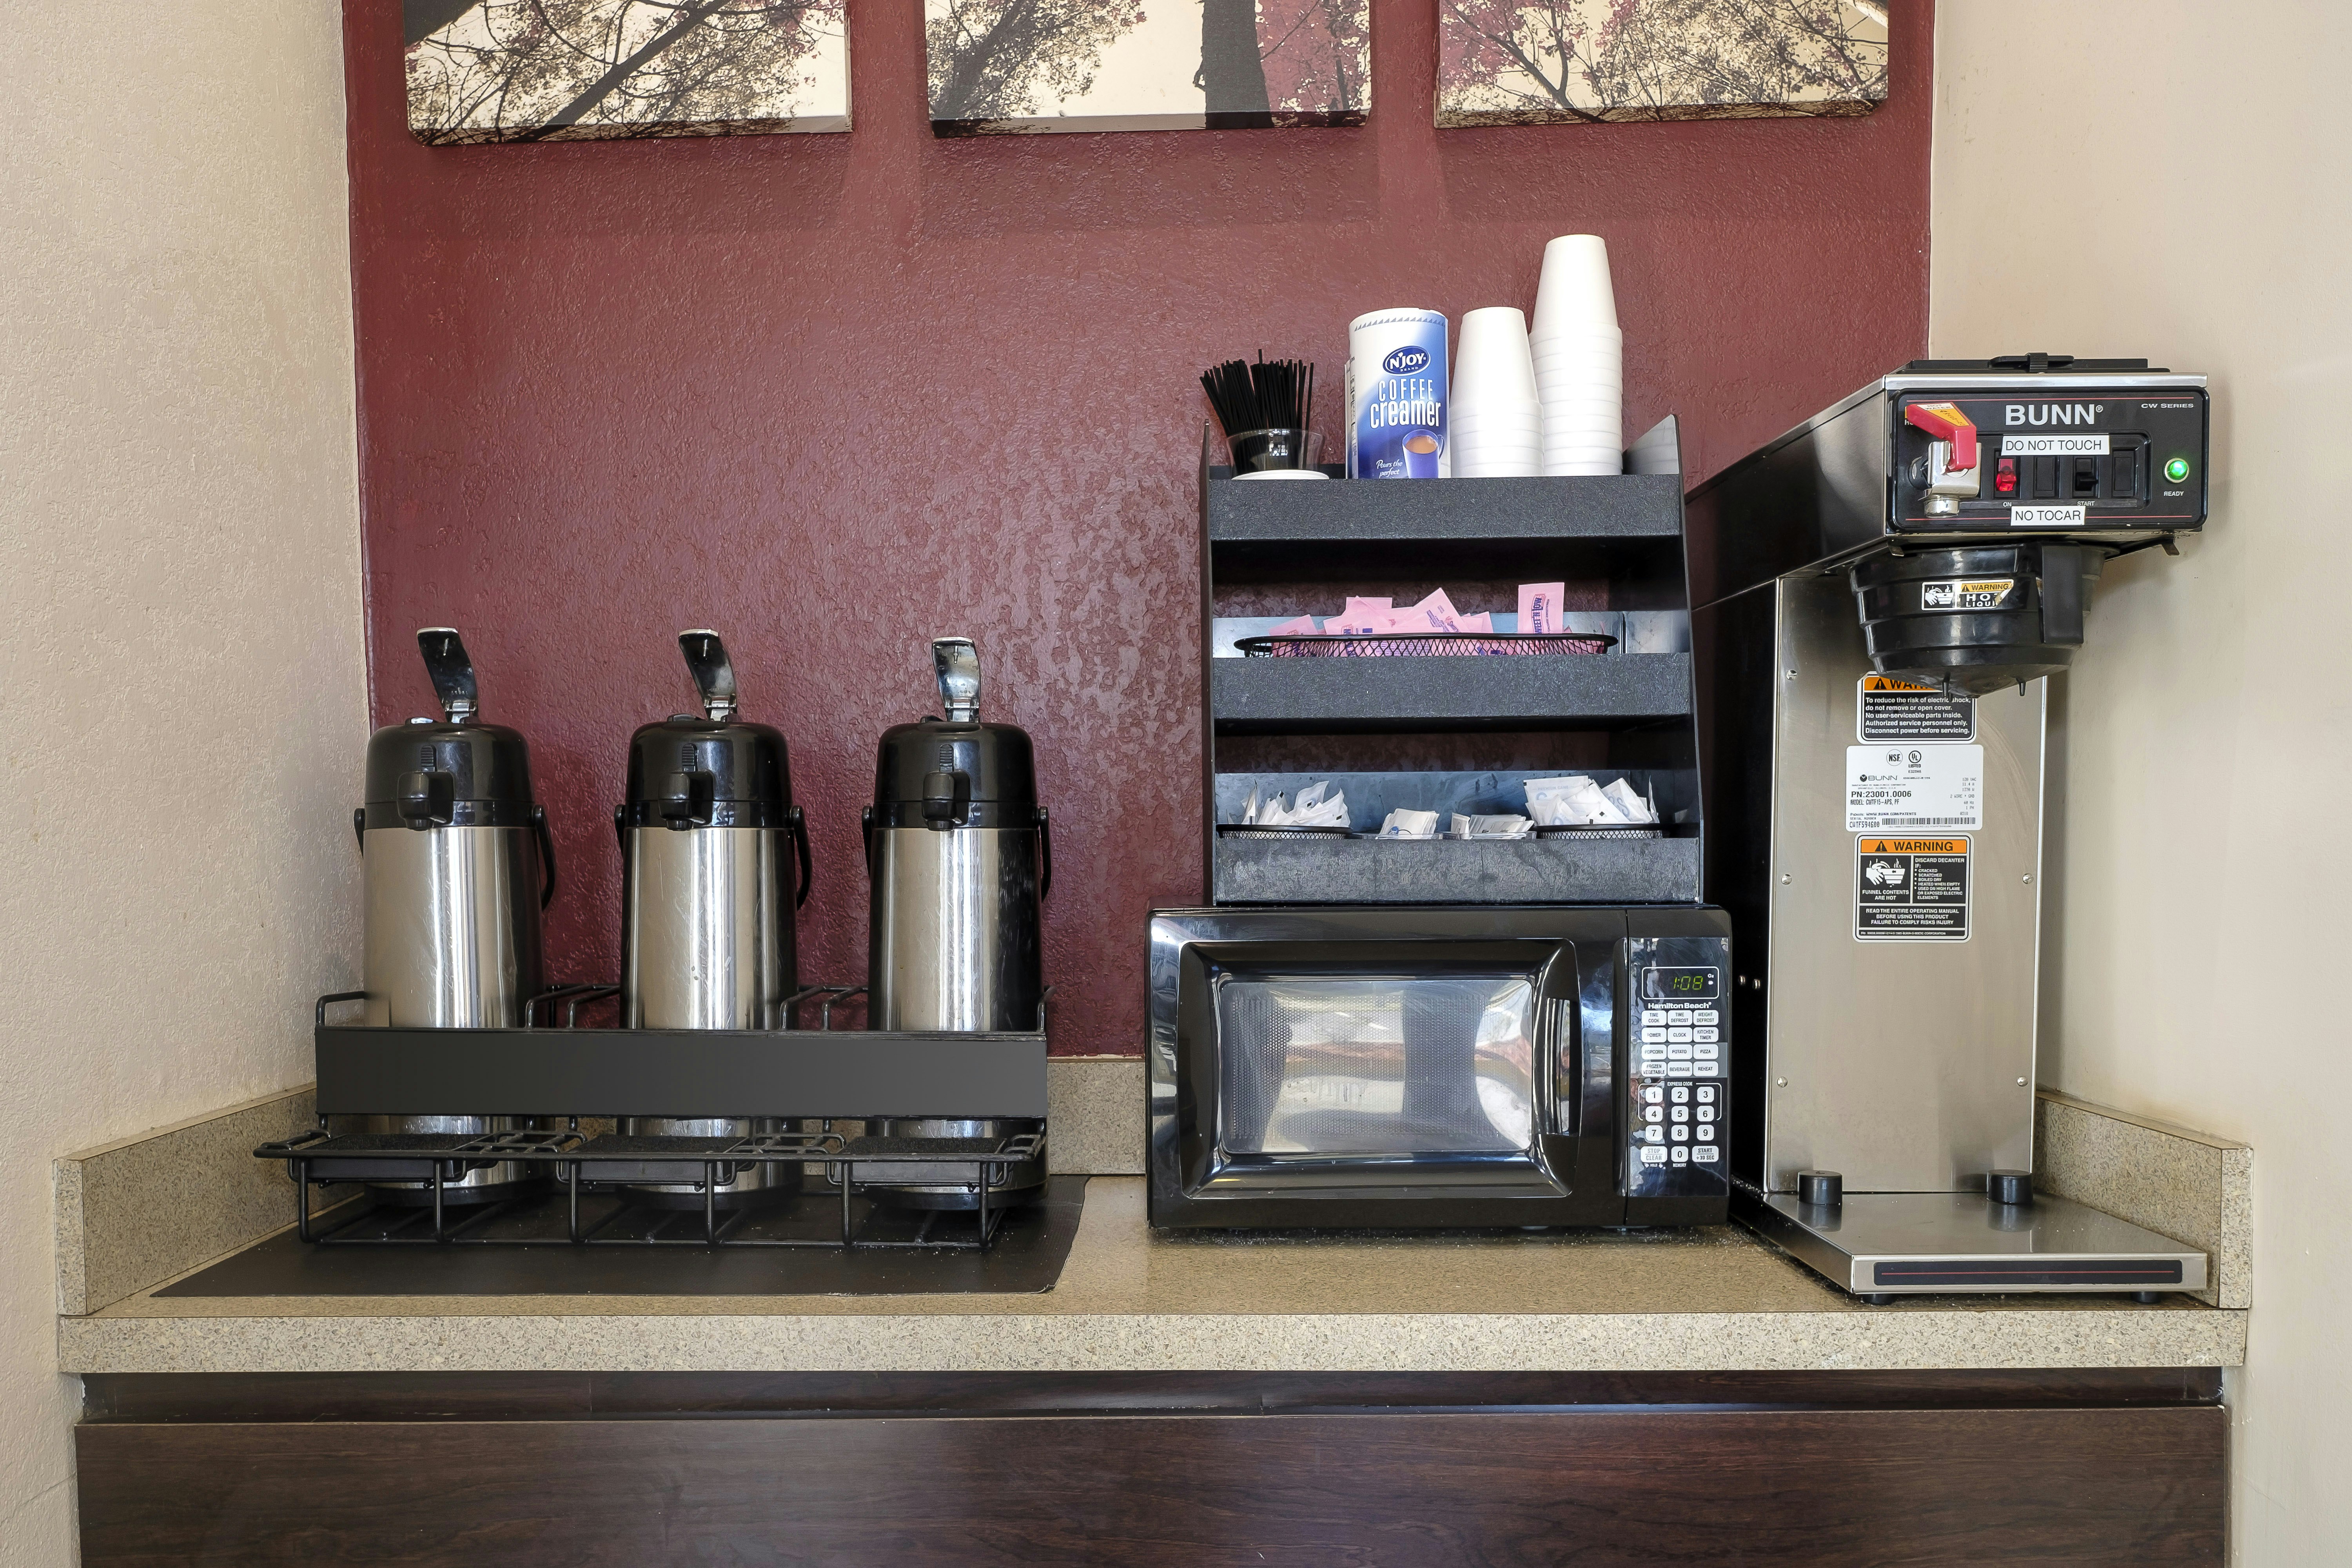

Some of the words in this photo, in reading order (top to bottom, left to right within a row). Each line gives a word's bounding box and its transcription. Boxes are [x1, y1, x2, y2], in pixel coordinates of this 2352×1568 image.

[1378, 378, 1433, 401] COFFEE
[1370, 400, 1441, 428] creamer
[2006, 441, 2024, 451] DO
[2028, 440, 2054, 450] NOT
[2057, 440, 2101, 450] TOUCH
[1376, 459, 1392, 469] Pours
[1379, 467, 1400, 478] perfect
[2016, 510, 2033, 521] NO
[2037, 510, 2081, 521] TOCAR
[1894, 841, 1953, 851] WARNING
[1673, 976, 1703, 990] 1:08
